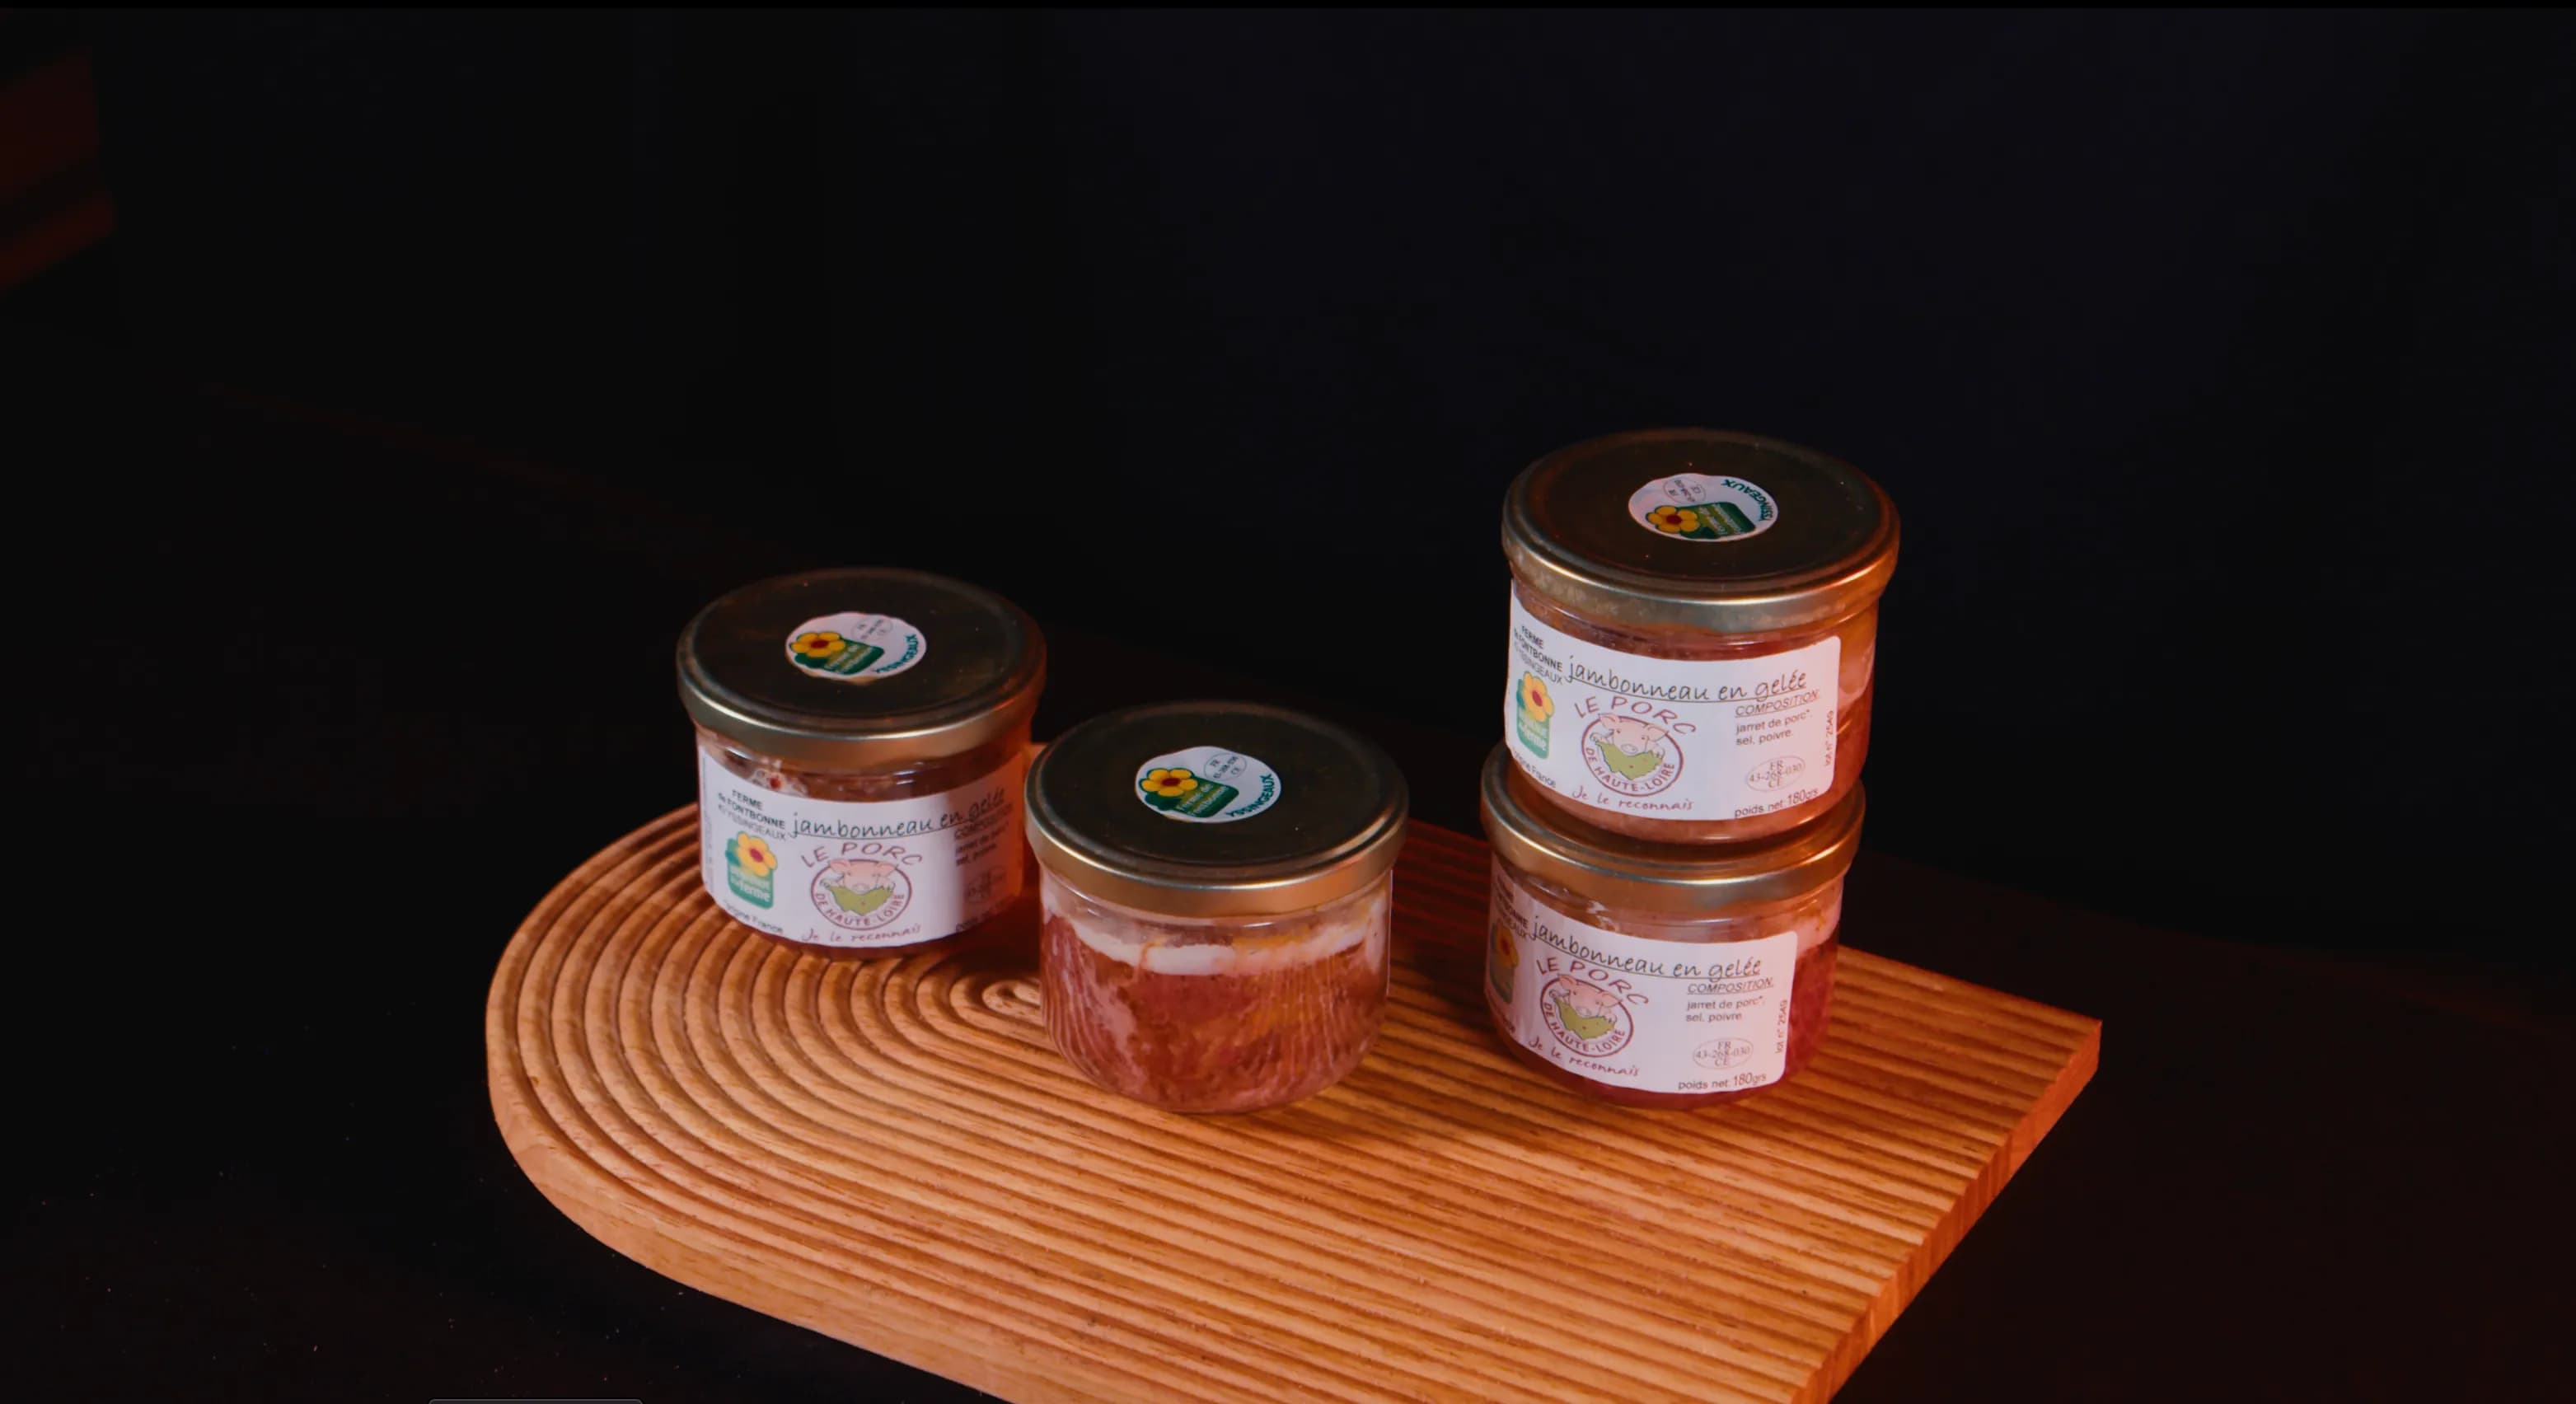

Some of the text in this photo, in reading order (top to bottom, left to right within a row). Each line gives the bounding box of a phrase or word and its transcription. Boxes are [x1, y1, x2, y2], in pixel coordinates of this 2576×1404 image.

[1566, 655, 1807, 702] jambonneau en gelée
[1575, 695, 1697, 734] LE PORC
[1768, 718, 1782, 728] de
[1735, 804, 1765, 819] poids
[790, 812, 934, 839] jambonneau
[801, 841, 923, 868] LE PORC
[1529, 915, 1664, 975] jambonneau
[1673, 962, 1702, 978] en
[1708, 956, 1761, 983] gelée
[1536, 957, 1649, 1005] LE PORC
[1719, 999, 1733, 1009] de
[1678, 1080, 1709, 1090] poids
